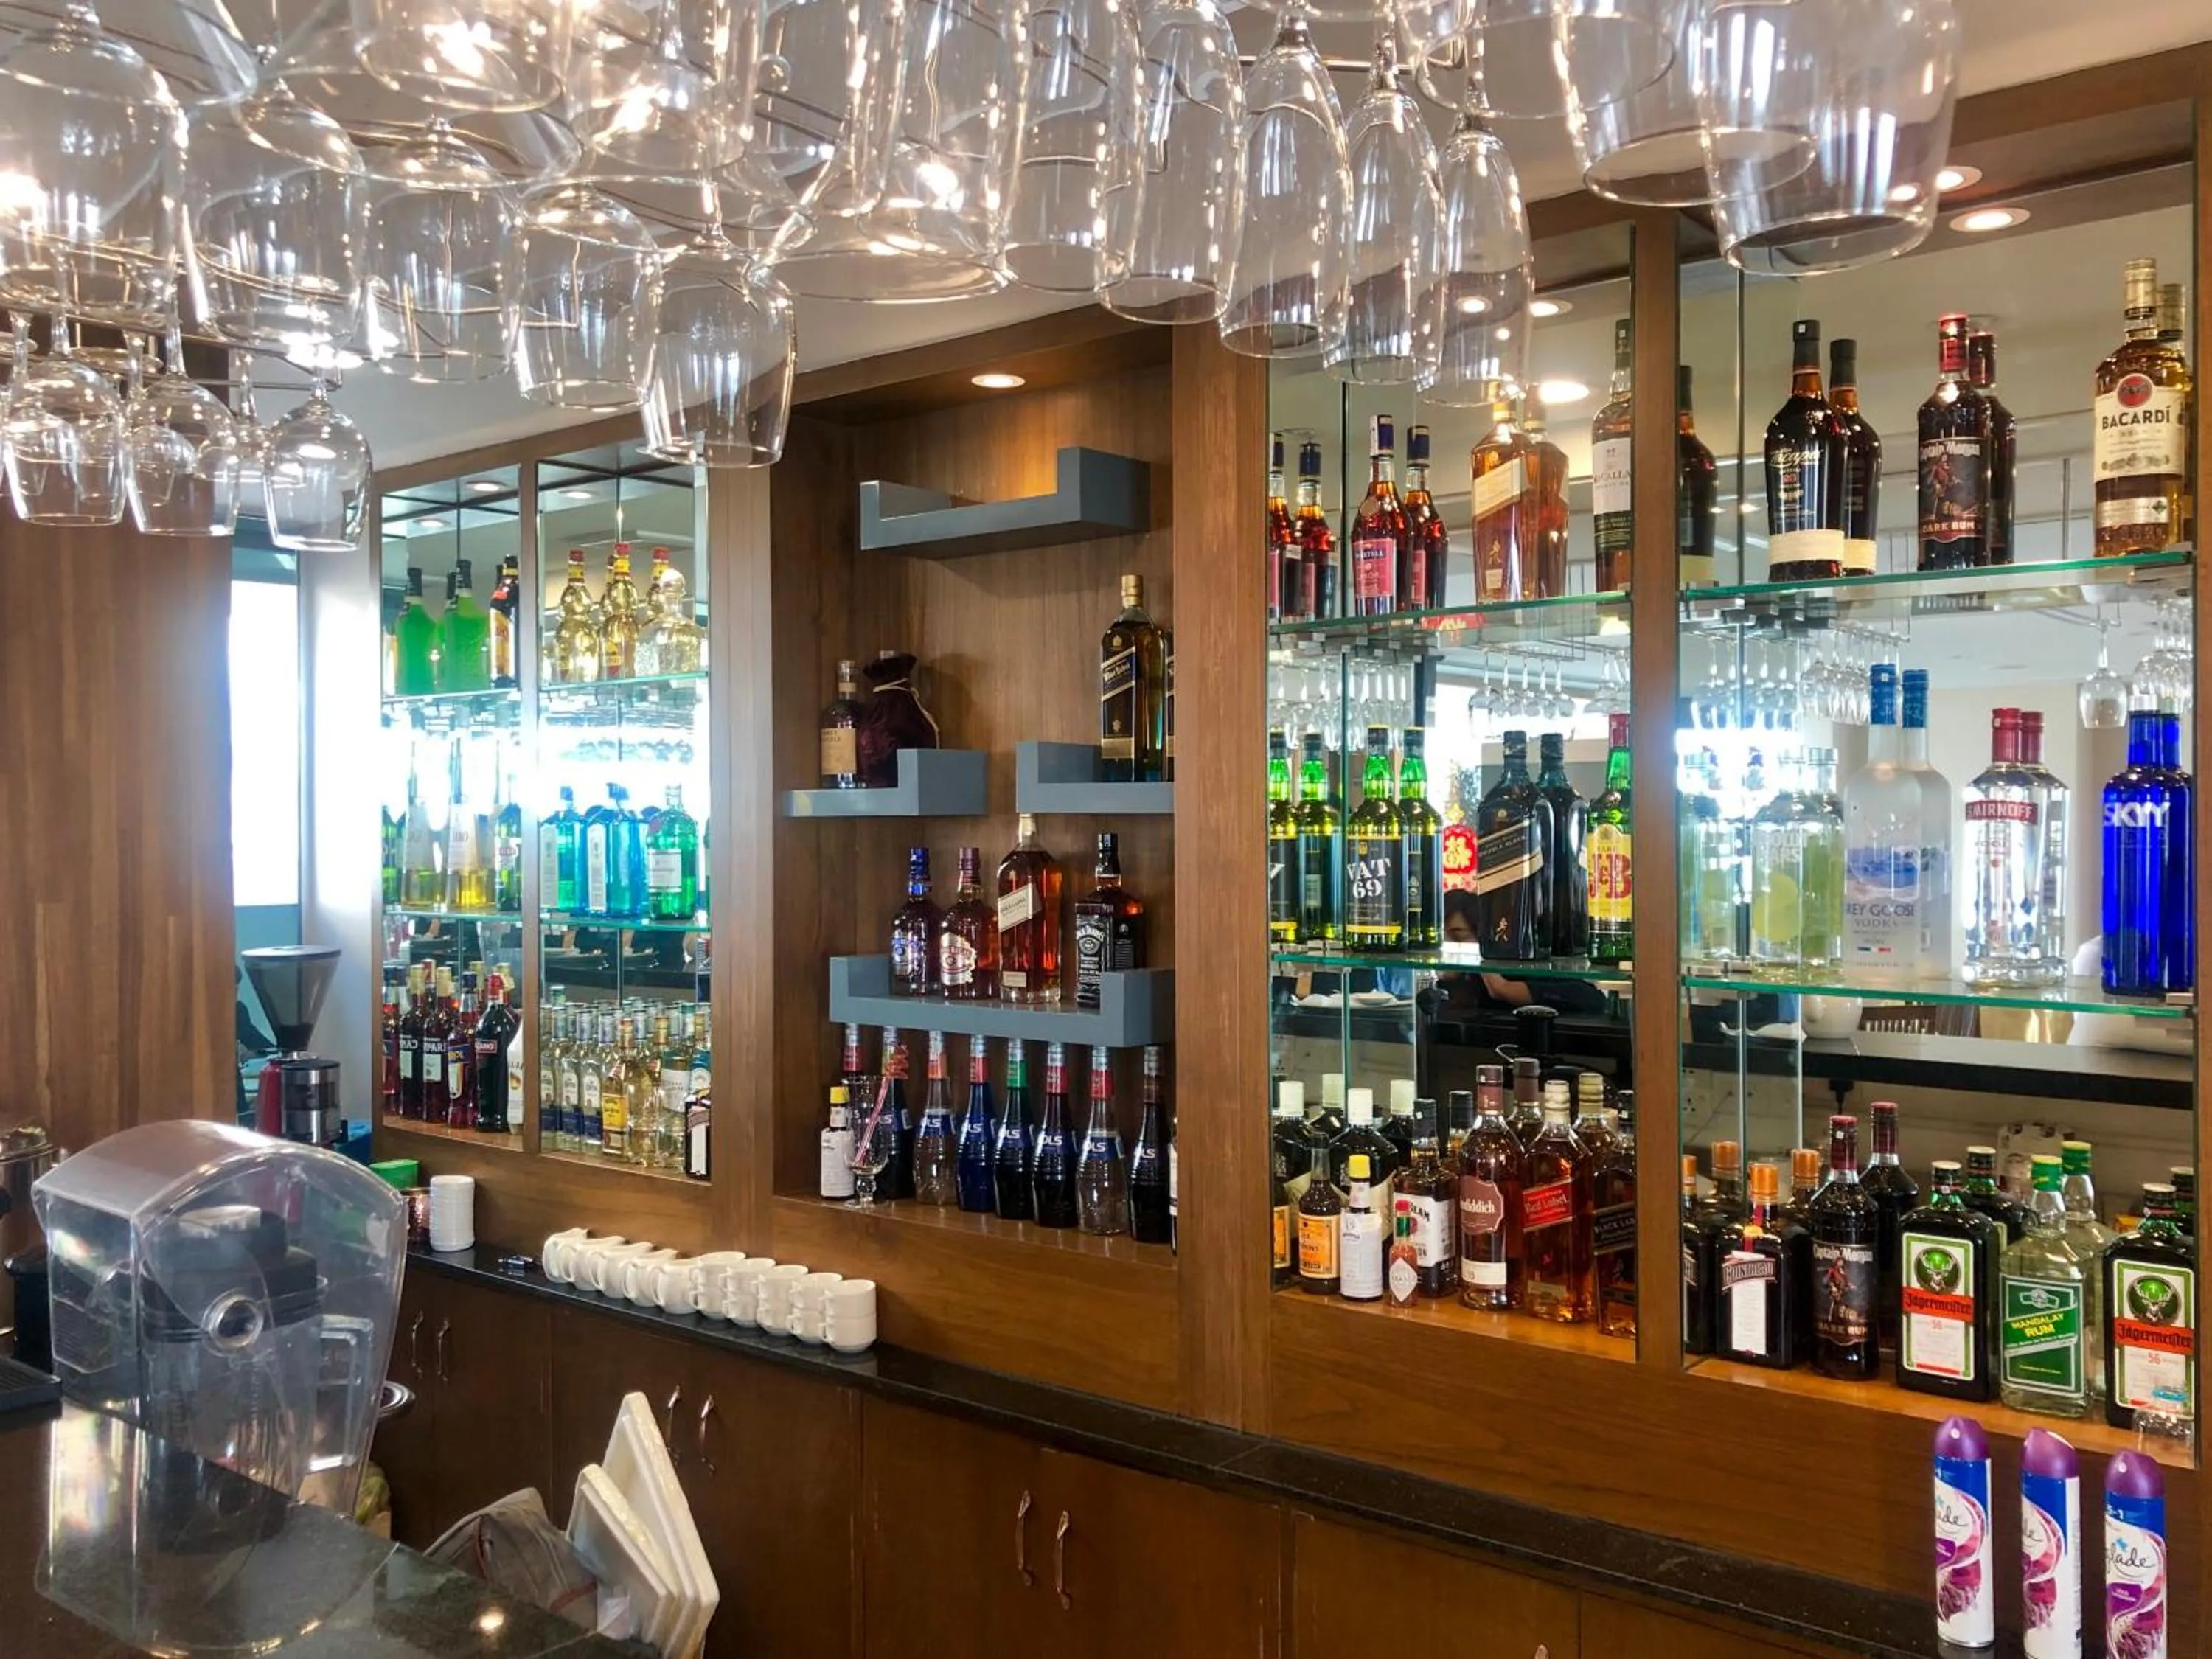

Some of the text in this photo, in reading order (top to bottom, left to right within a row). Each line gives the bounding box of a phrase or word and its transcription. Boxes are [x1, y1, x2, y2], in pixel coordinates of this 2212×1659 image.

[2102, 406, 2171, 430] BACARDÍ
[1346, 858, 1391, 881] VAT
[1352, 879, 1382, 899] 69
[2024, 1324, 2056, 1338] RUM
